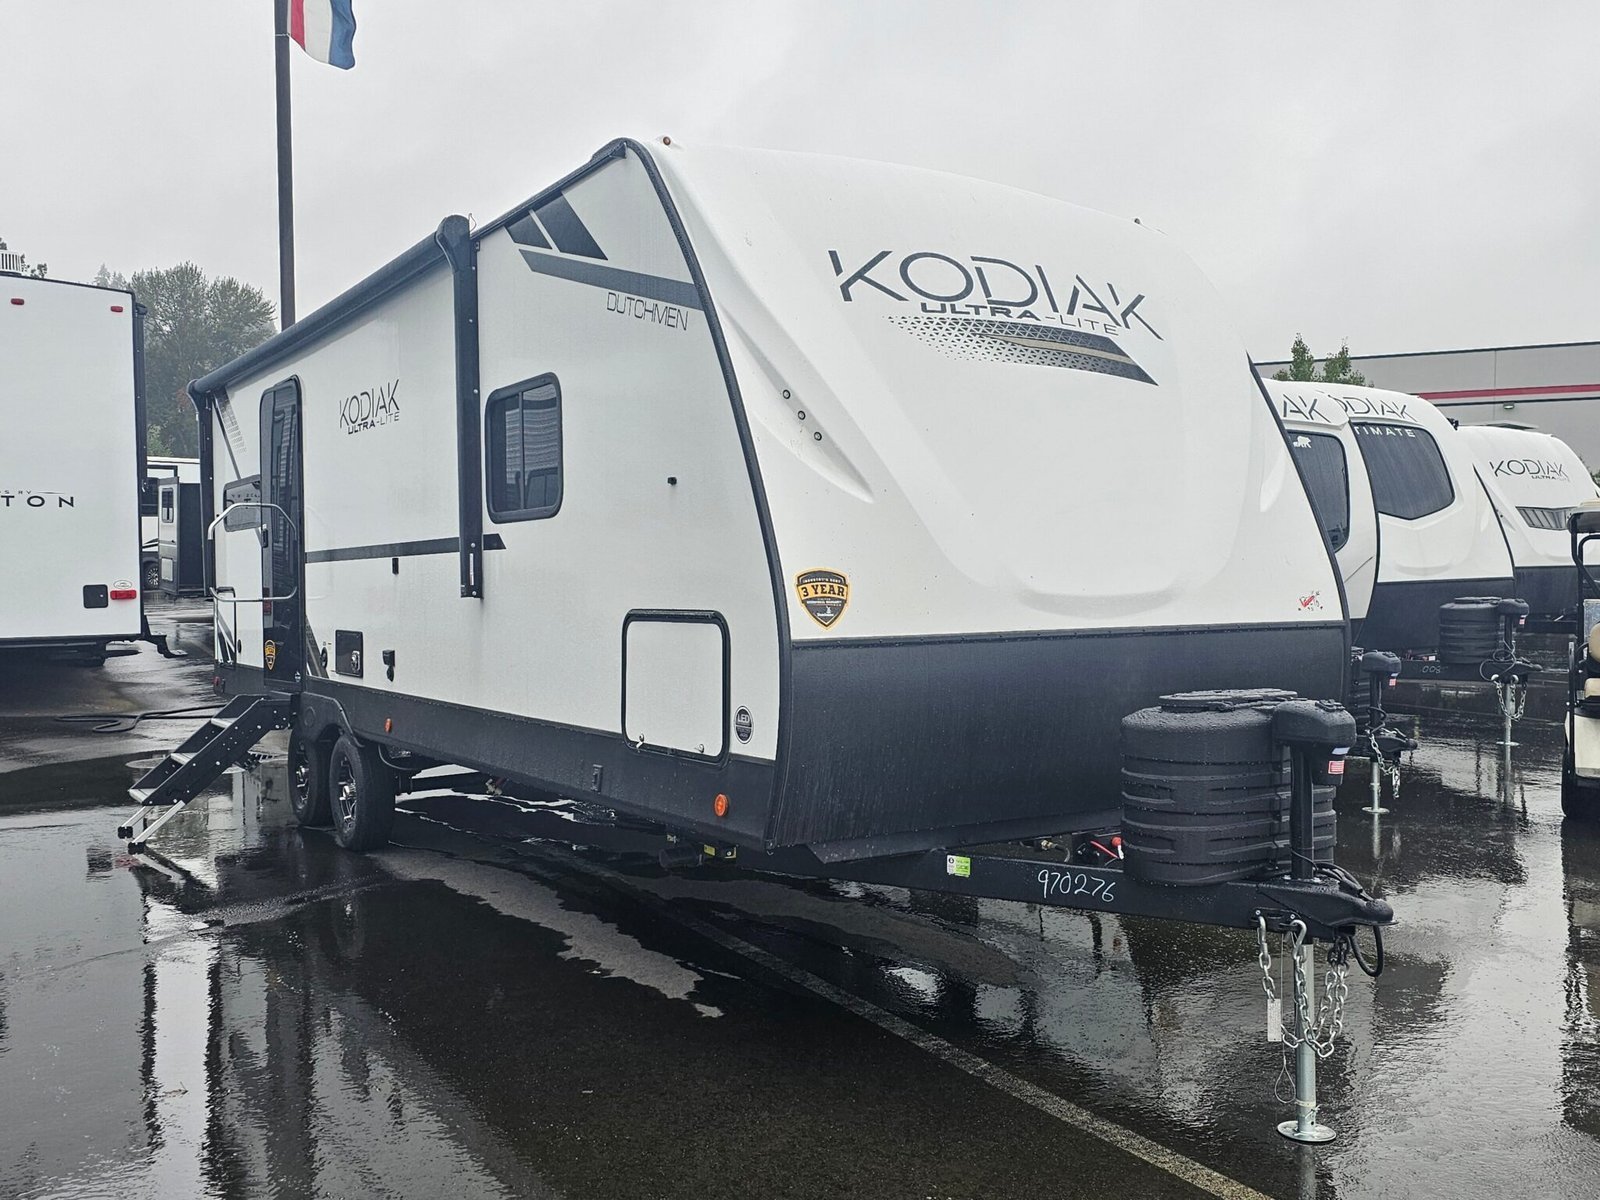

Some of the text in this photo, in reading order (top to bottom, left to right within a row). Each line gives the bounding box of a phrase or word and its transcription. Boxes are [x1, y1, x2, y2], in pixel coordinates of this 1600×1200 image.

[607, 292, 688, 331] DUTCHMEN
[828, 250, 1164, 341] KODIAK
[920, 302, 1119, 336] ULTRA-LITE
[339, 379, 400, 429] KODIAK
[348, 411, 400, 435] ULTRA-LITE
[1489, 459, 1570, 482] KODIAK
[0, 495, 74, 508] TON
[801, 584, 845, 597] 3 YEAR
[1038, 869, 1116, 902] 970276
